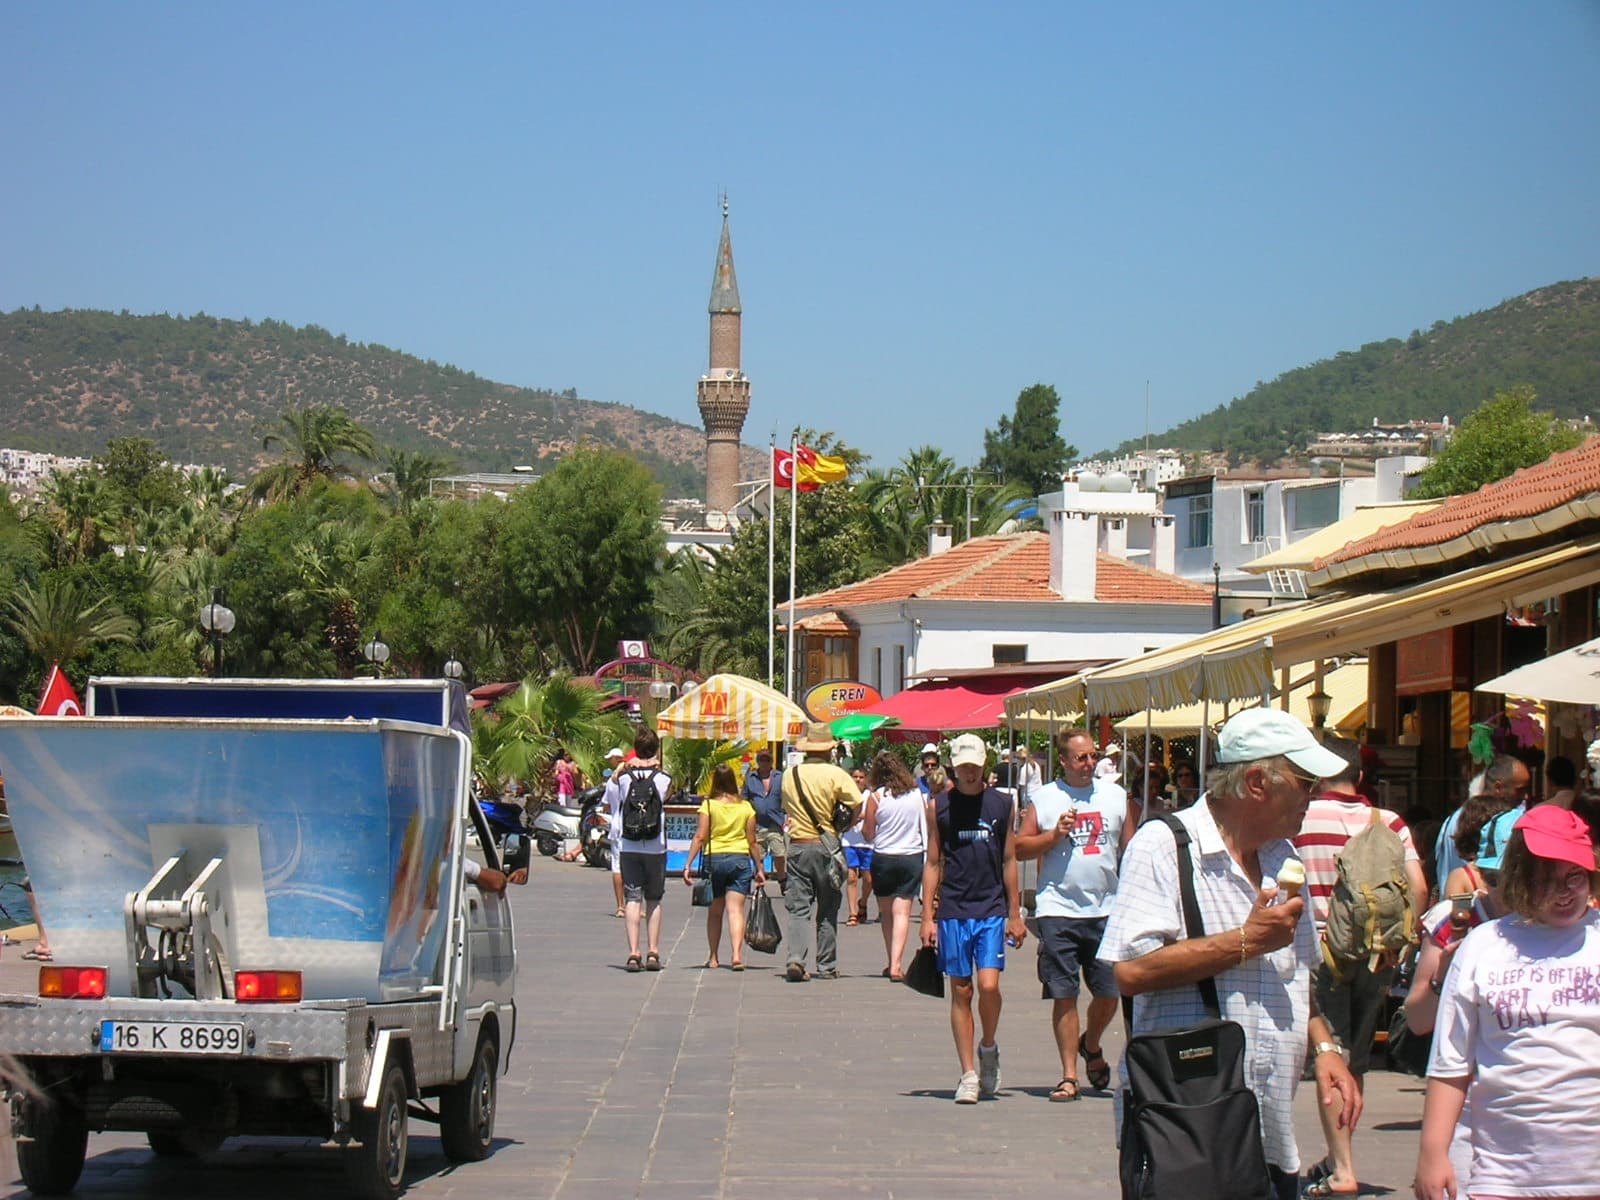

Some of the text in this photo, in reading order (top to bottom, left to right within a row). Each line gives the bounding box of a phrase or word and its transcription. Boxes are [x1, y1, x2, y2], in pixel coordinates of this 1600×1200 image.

[831, 687, 865, 701] EREN
[1487, 968, 1525, 986] SLEEP
[1529, 966, 1545, 983] IS
[1549, 965, 1592, 985] OFTEN
[1486, 987, 1533, 1010] PART
[115, 1025, 139, 1048] 16
[152, 1026, 168, 1049] K
[180, 1027, 240, 1050] 8699
